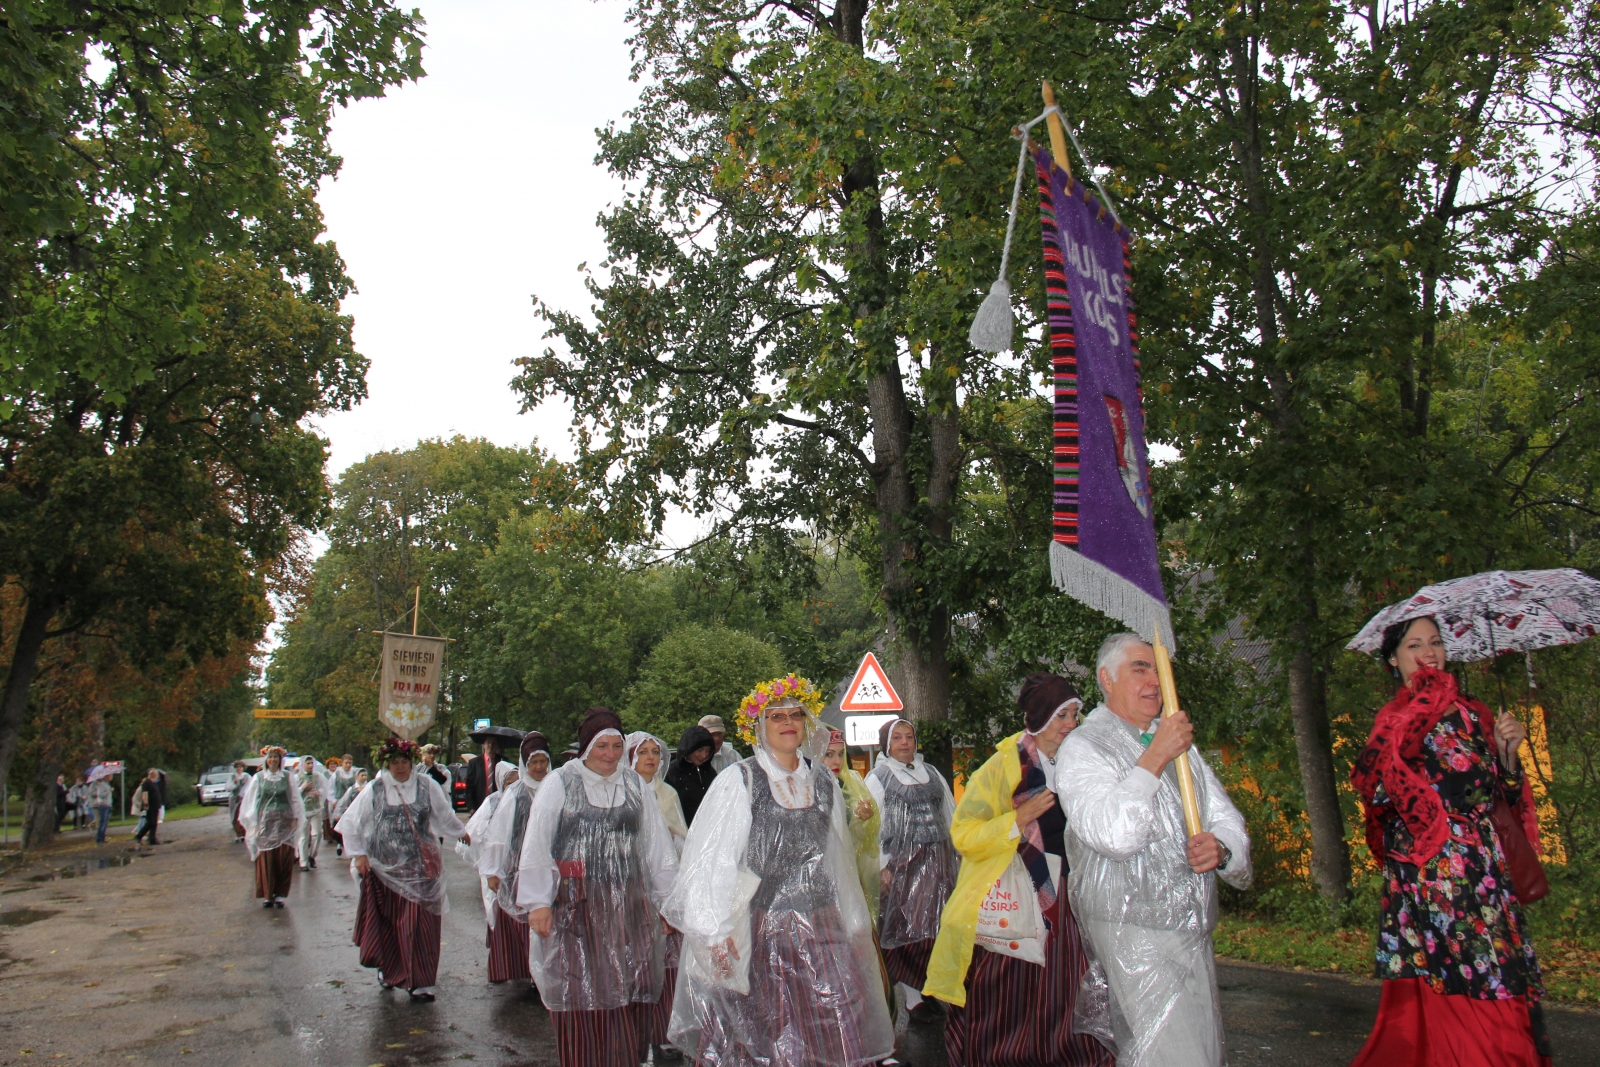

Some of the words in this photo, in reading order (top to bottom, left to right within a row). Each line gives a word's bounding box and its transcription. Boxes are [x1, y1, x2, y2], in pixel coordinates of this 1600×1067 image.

[400, 664, 427, 678] KORIS
[859, 730, 876, 741] 200
[975, 934, 1008, 947] Swedbank
